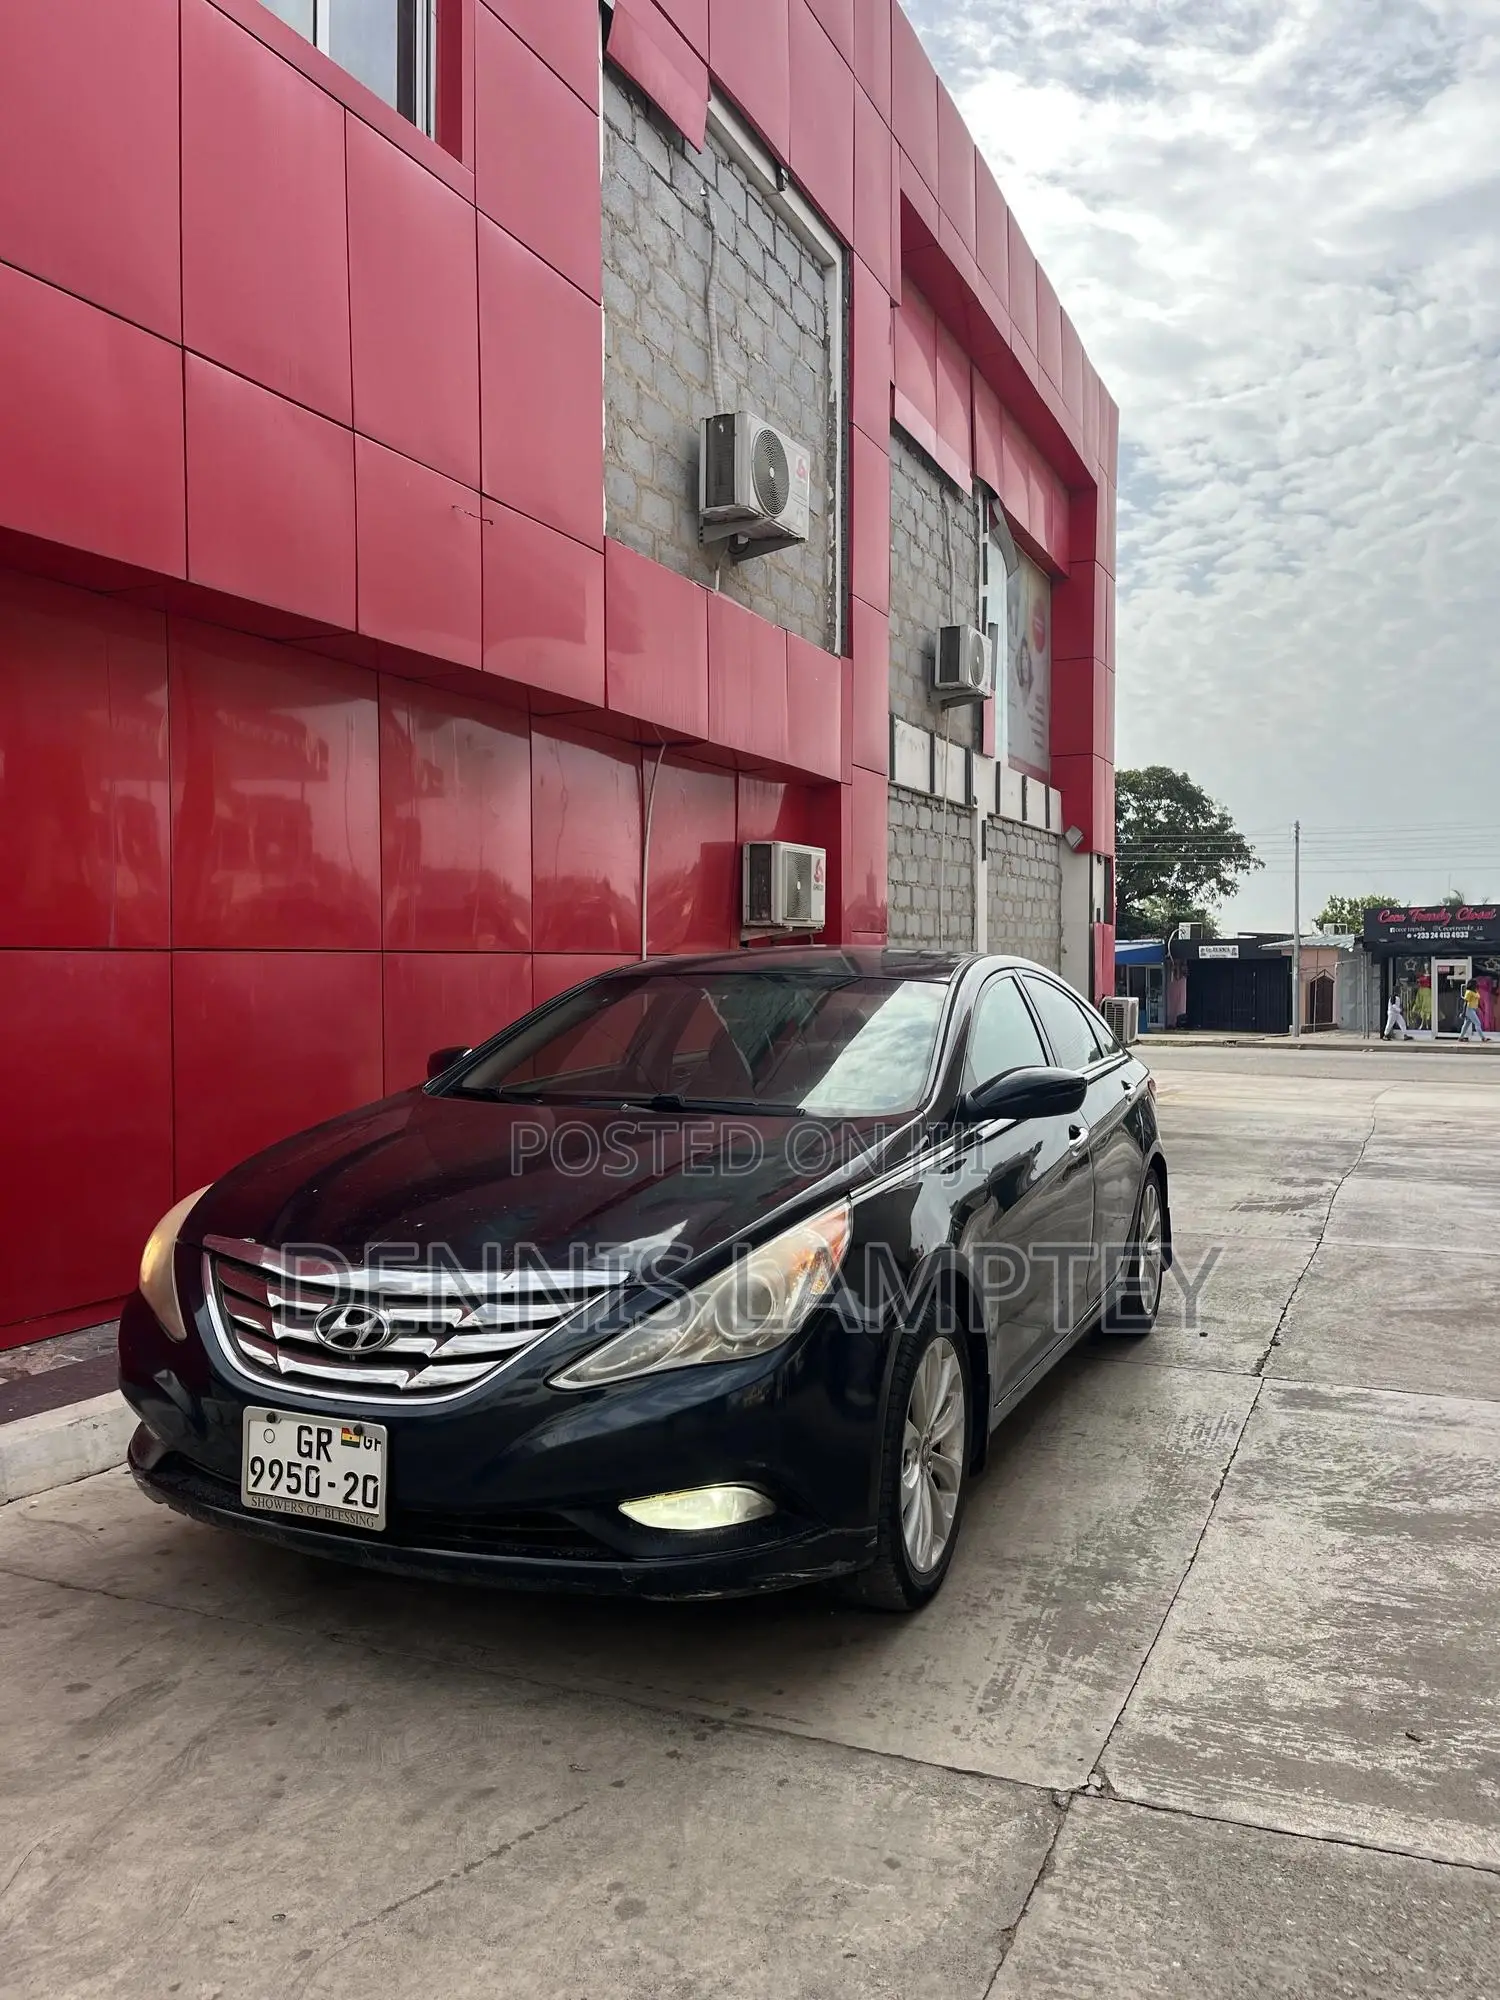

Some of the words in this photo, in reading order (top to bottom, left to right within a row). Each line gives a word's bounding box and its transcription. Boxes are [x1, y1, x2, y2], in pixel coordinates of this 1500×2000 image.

[1413, 931, 1430, 939] +233
[1430, 931, 1439, 939] 24
[297, 1425, 333, 1462] GR
[251, 1496, 304, 1514] SHOWERS
[306, 1504, 321, 1516] OF
[324, 1509, 375, 1528] BLESSING
